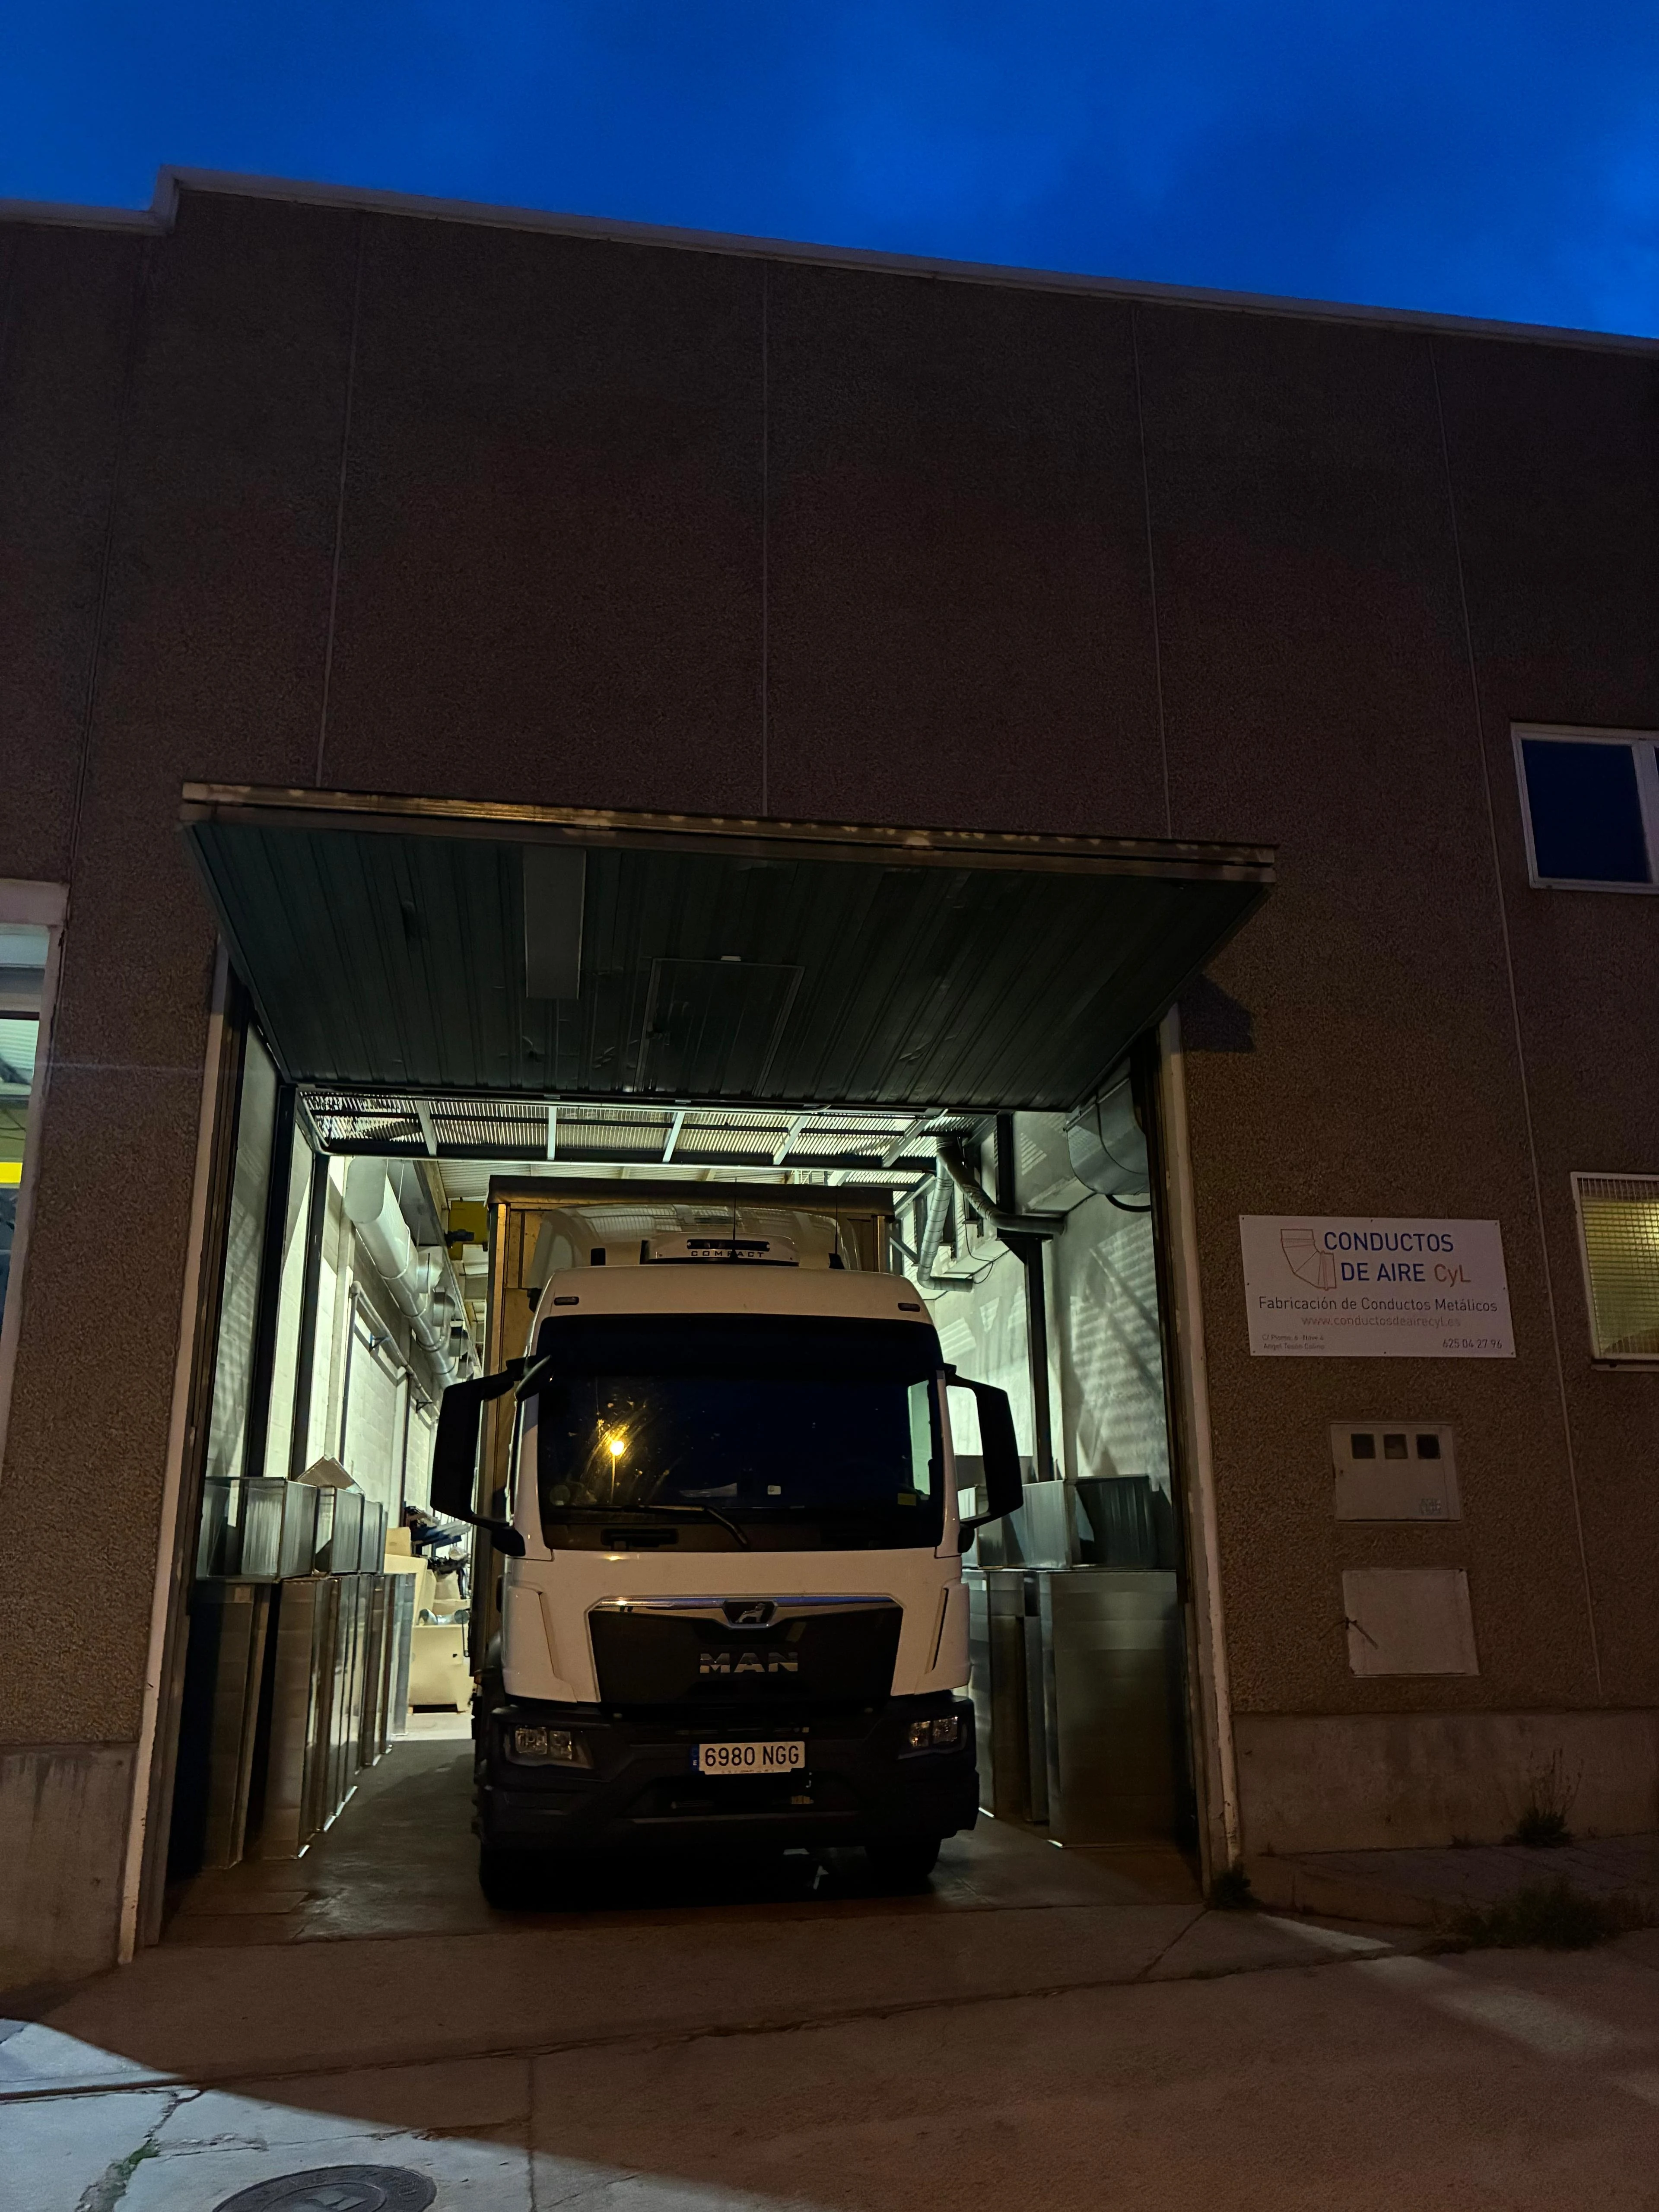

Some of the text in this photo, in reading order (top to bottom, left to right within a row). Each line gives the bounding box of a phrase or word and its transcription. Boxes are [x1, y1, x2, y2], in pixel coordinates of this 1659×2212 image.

[1324, 1231, 1454, 1252] CONDUCTOS
[1341, 1262, 1471, 1287] DE AIRE CyL
[1259, 1296, 1497, 1312] Fabricación de Conductos Metálicos
[1443, 1338, 1503, 1349] 625 04 27 96
[699, 1652, 798, 1673] MAN
[705, 1747, 755, 1767] 6980
[763, 1745, 799, 1765] NGG
